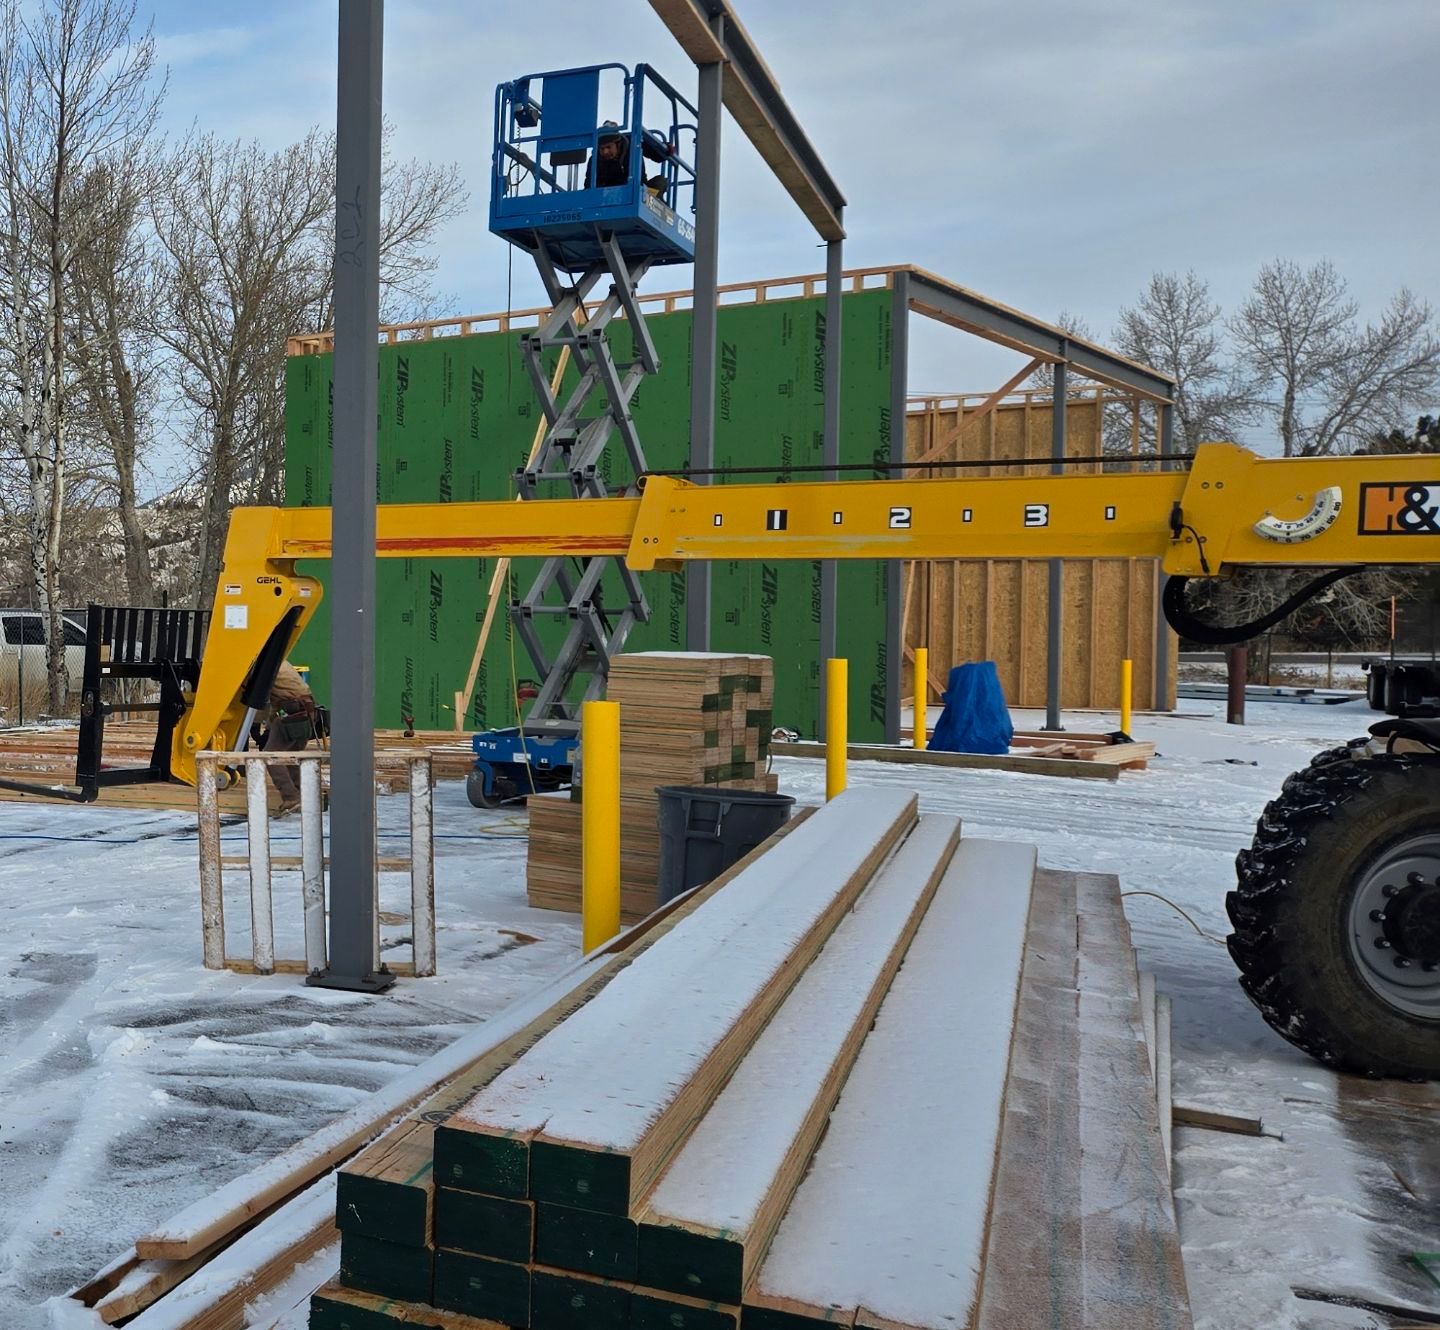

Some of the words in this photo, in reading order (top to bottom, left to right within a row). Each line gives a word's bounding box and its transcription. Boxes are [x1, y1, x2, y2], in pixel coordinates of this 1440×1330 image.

[890, 508, 911, 528] 2
[1025, 505, 1048, 527] 3
[257, 576, 282, 584] GEHL
